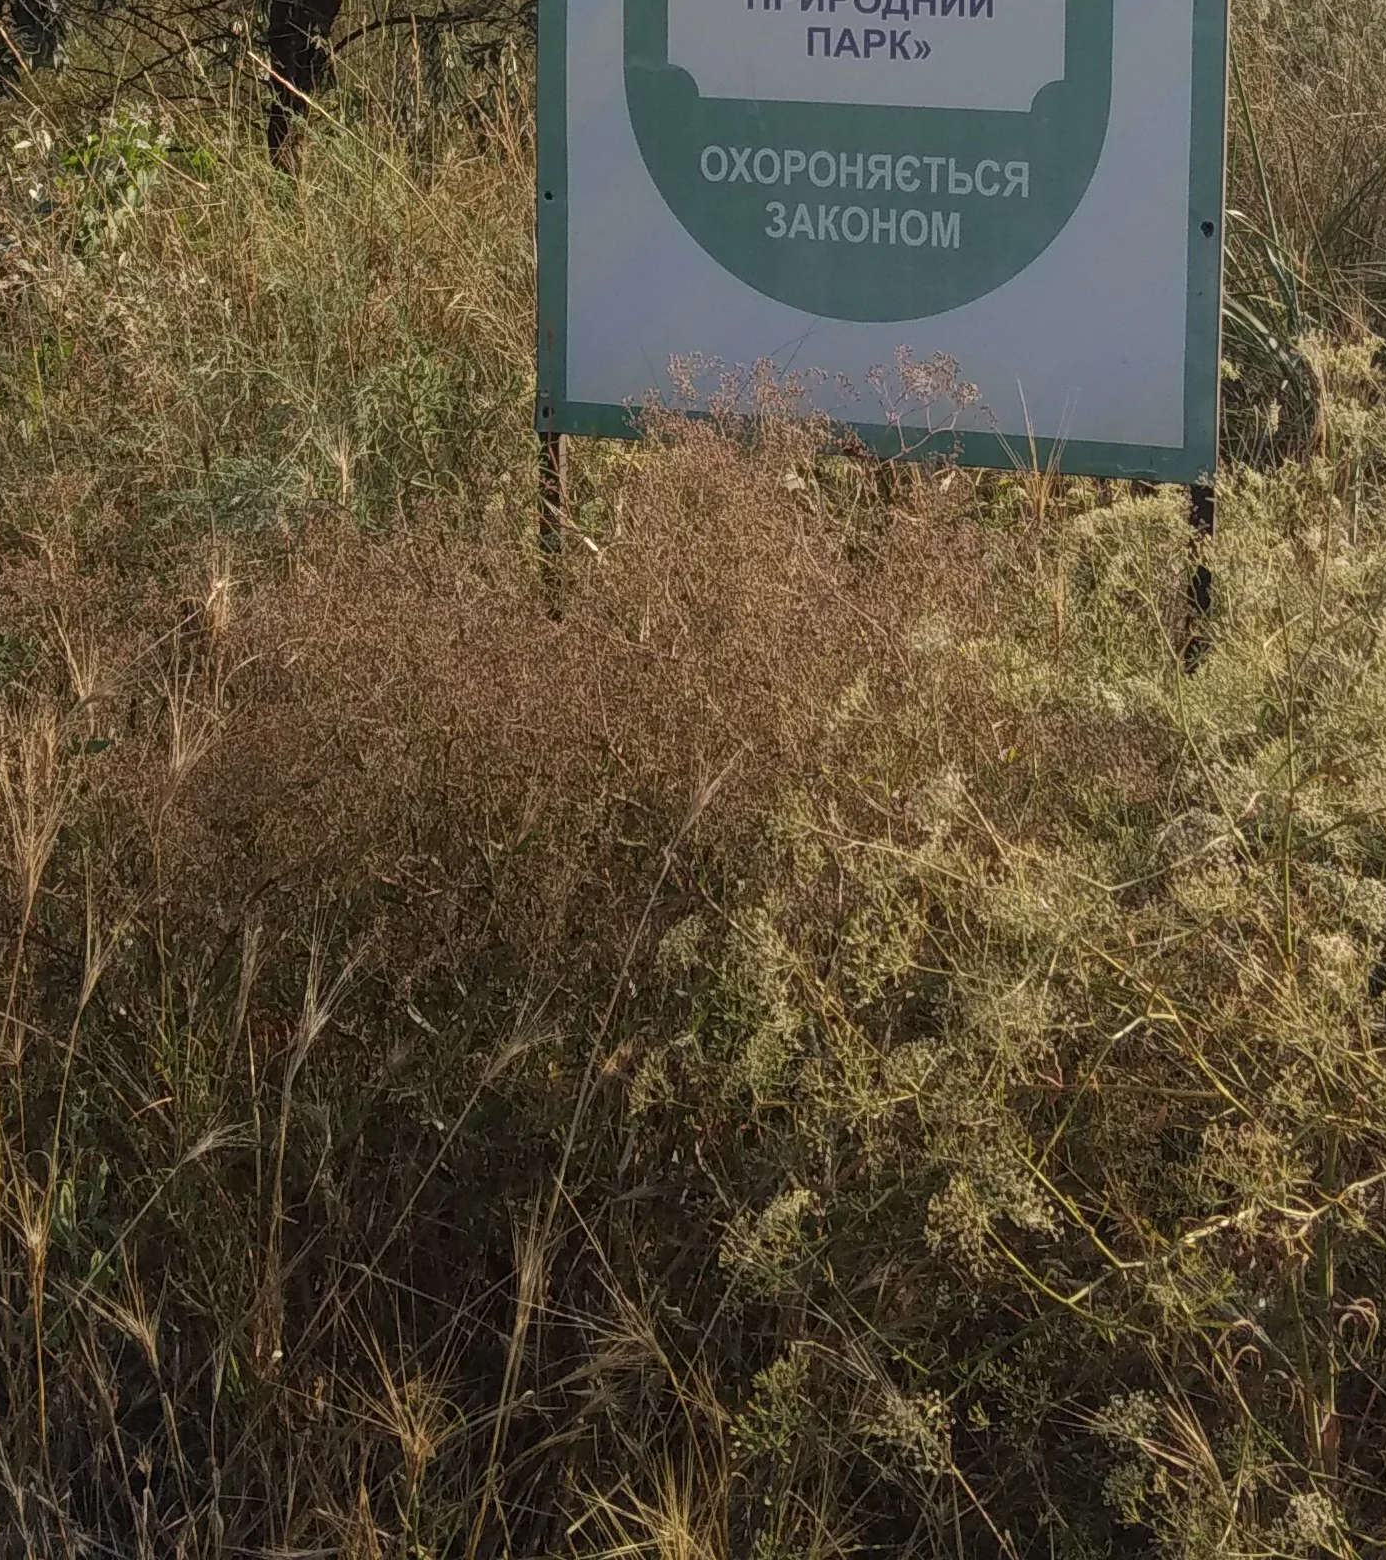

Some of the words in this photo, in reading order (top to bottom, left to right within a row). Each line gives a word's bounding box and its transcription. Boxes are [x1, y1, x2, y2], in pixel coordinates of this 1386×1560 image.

[806, 27, 932, 63] ПАРК»
[700, 144, 1030, 198] ОХОРОНЯЄТЬСЯ
[764, 202, 960, 250] ЗАКОНОМ
